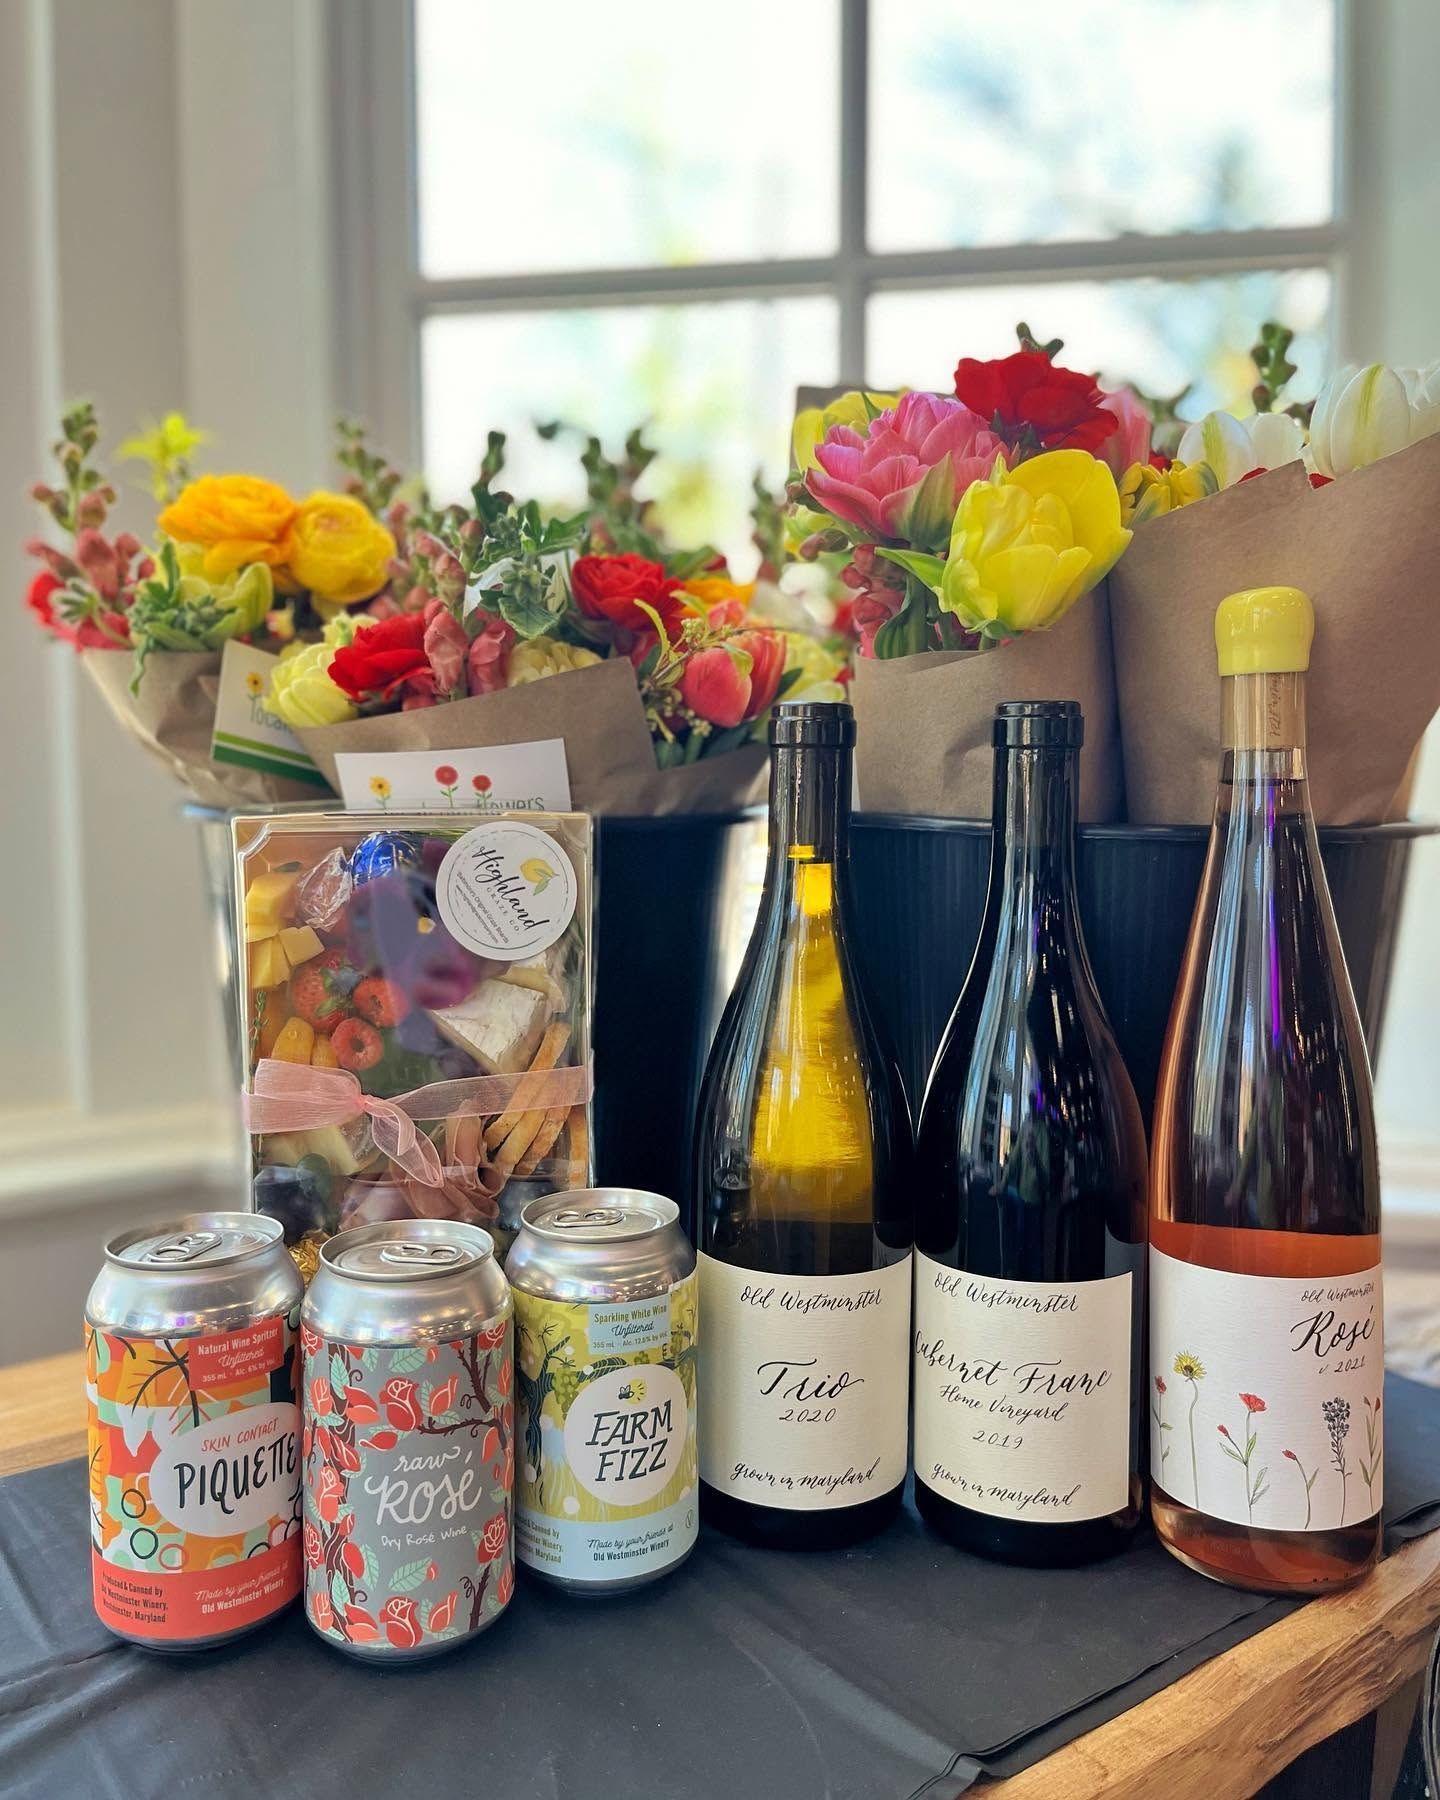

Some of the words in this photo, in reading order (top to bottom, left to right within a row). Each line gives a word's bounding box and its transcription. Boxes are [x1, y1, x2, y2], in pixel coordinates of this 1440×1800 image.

[472, 846, 550, 931] Highland
[486, 887, 508, 915] GRAZE
[740, 1286, 775, 1309] Old
[780, 1288, 881, 1313] Westminster
[934, 1272, 961, 1297] Old
[967, 1282, 1078, 1312] Westminster
[1301, 1289, 1324, 1303] Old
[594, 1312, 629, 1324] Sparkling
[631, 1309, 650, 1320] White
[652, 1305, 667, 1315] Wine
[198, 1341, 229, 1355] Natural
[232, 1338, 250, 1349] Wine
[252, 1328, 278, 1344] Spritzer
[611, 1320, 655, 1339] Unfiltered
[218, 1347, 264, 1368] Unfiltered
[1334, 1355, 1365, 1373] 2021
[202, 1374, 216, 1383] 355
[757, 1358, 865, 1401] Trio
[1013, 1359, 1112, 1396] Franc
[779, 1408, 836, 1422] 2020
[939, 1384, 983, 1410] Home
[989, 1394, 1069, 1425] Vineyard
[201, 1431, 230, 1453] SKIN
[237, 1418, 279, 1447] CONTACT
[585, 1399, 673, 1447] FARM
[972, 1430, 1023, 1449] 2019
[393, 1445, 461, 1472] raw
[595, 1438, 668, 1482] FIZZ
[173, 1431, 297, 1515] PIQUETTE
[730, 1462, 776, 1488] grown
[780, 1473, 793, 1489] in
[930, 1463, 967, 1492] grown
[971, 1482, 984, 1499] in
[381, 1535, 400, 1551] Dry
[441, 1525, 467, 1540] Wine
[587, 1538, 612, 1551] Made
[614, 1539, 623, 1550] by
[594, 1552, 604, 1561] Old
[607, 1545, 648, 1560] Westminster
[650, 1538, 669, 1551] Winery
[129, 1583, 152, 1595] Canned
[155, 1586, 162, 1597] by
[193, 1588, 223, 1602] Made
[225, 1586, 235, 1597] by
[202, 1604, 215, 1614] Old
[217, 1589, 262, 1611] Westminster
[264, 1577, 284, 1594] Winery
[134, 1610, 166, 1623] Maryland
